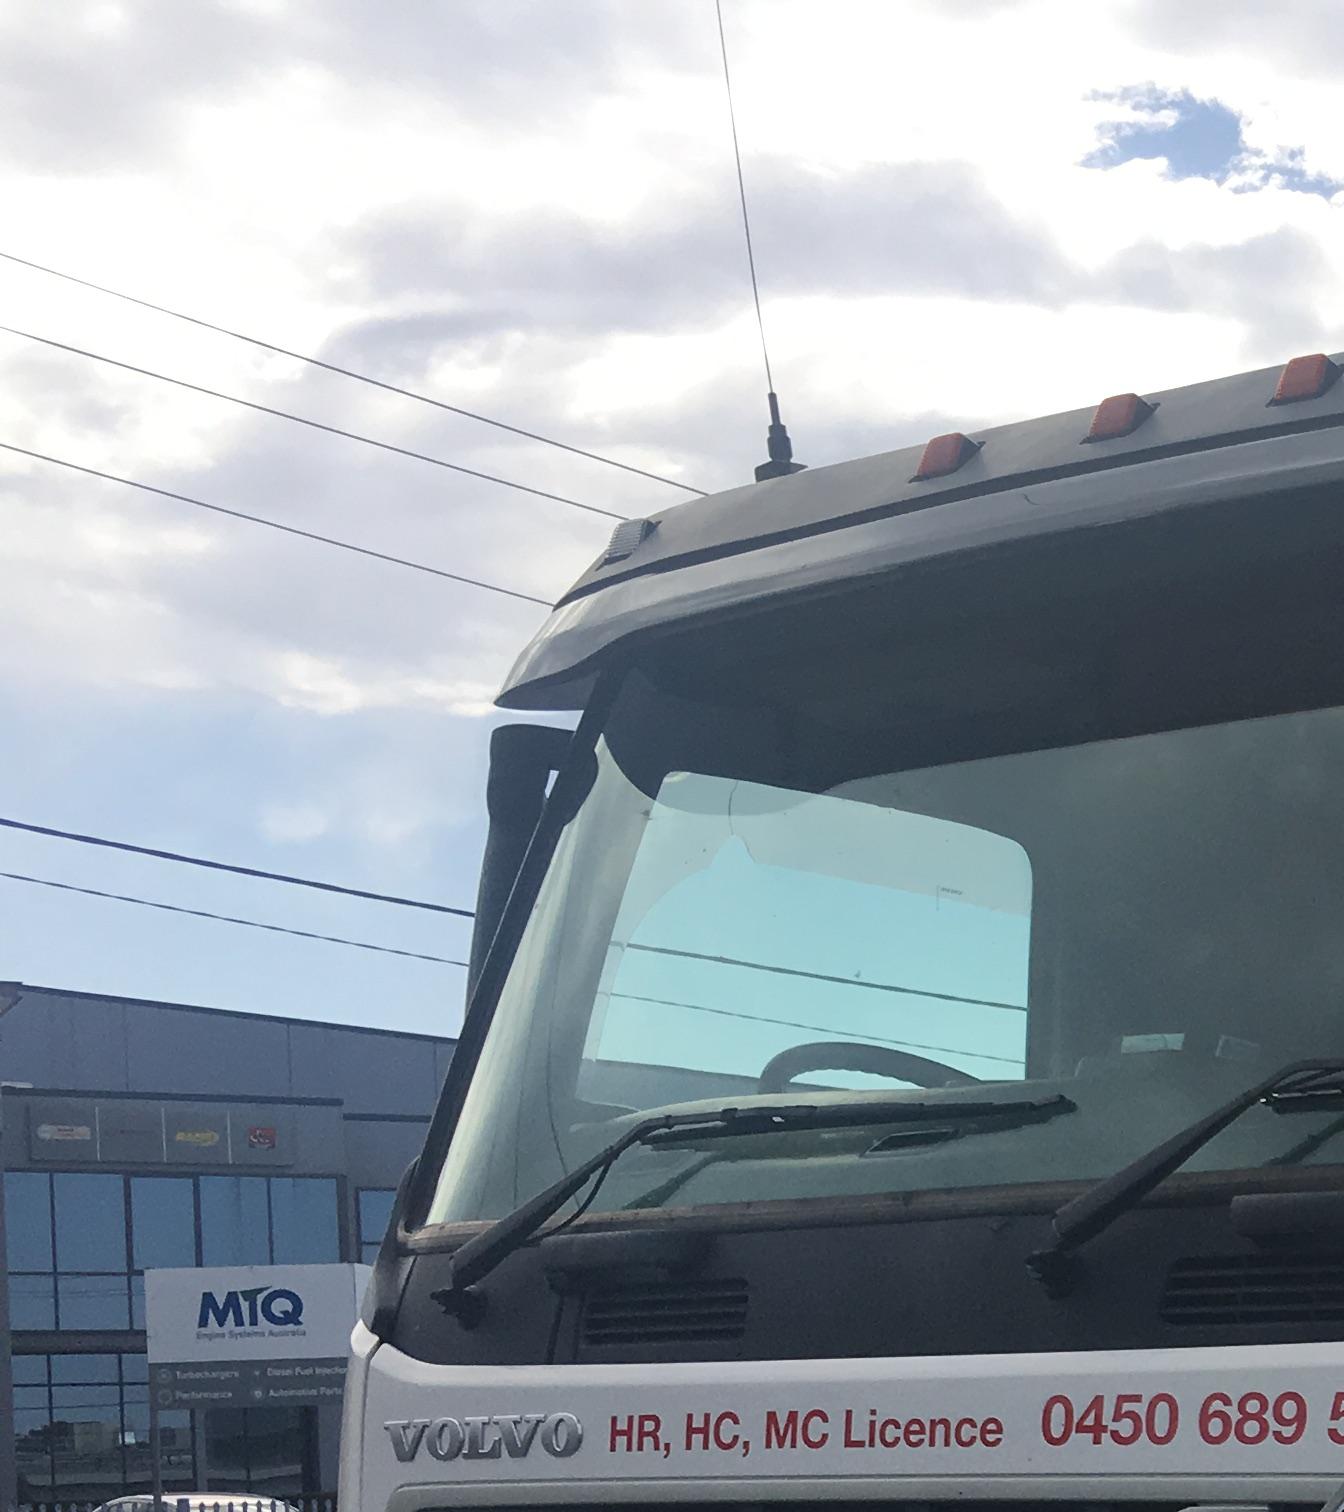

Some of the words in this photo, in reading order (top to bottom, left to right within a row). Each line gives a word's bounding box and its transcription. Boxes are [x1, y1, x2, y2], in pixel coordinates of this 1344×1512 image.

[197, 1285, 304, 1328] MTQ
[384, 1412, 584, 1462] VOLVO
[608, 1413, 671, 1459] HR,
[683, 1412, 751, 1457] HC,
[764, 1409, 830, 1452] MC
[843, 1408, 1004, 1450] Licence
[1041, 1392, 1180, 1446] 0450
[1198, 1390, 1308, 1446] 689
